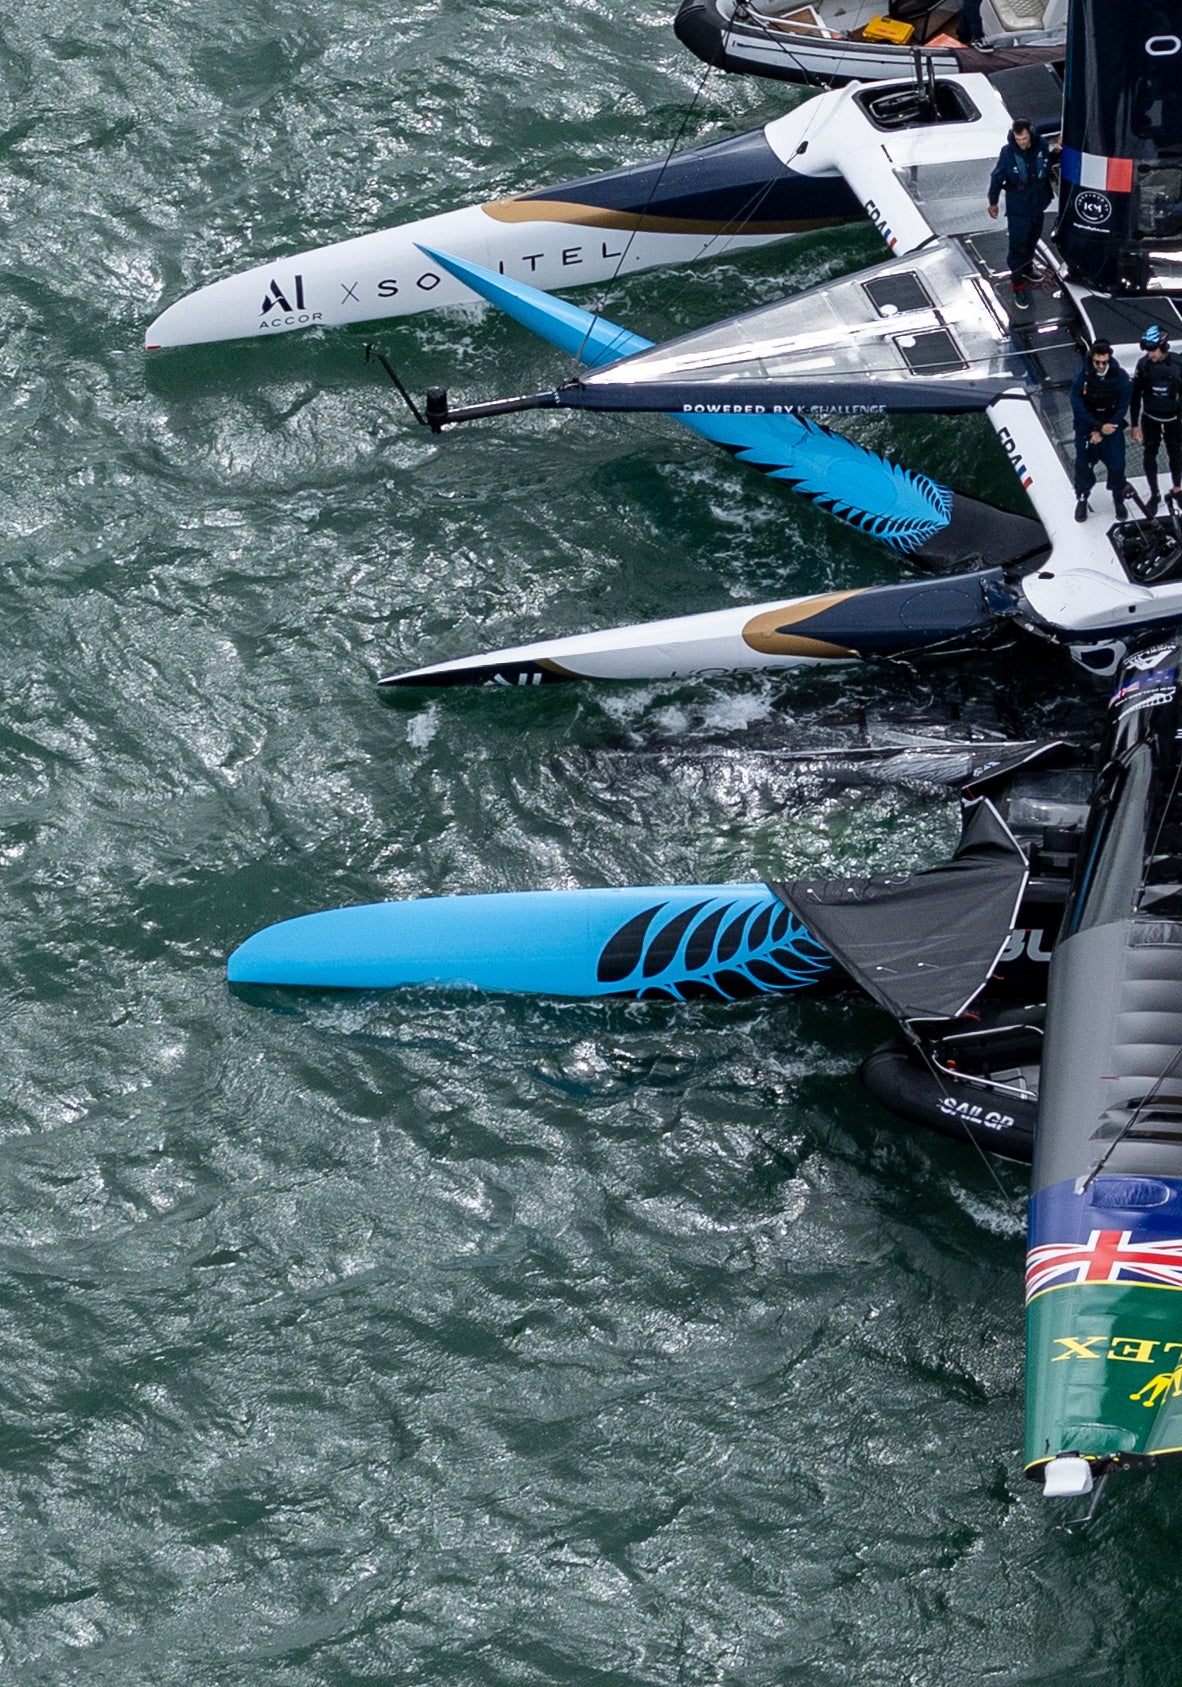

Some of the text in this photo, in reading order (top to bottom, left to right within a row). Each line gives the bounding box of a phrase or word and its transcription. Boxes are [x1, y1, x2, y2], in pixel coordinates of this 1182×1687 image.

[378, 242, 622, 298] SOITEL
[259, 312, 322, 329] ACCOR
[683, 404, 766, 413] POWERED
[773, 405, 794, 413] BY
